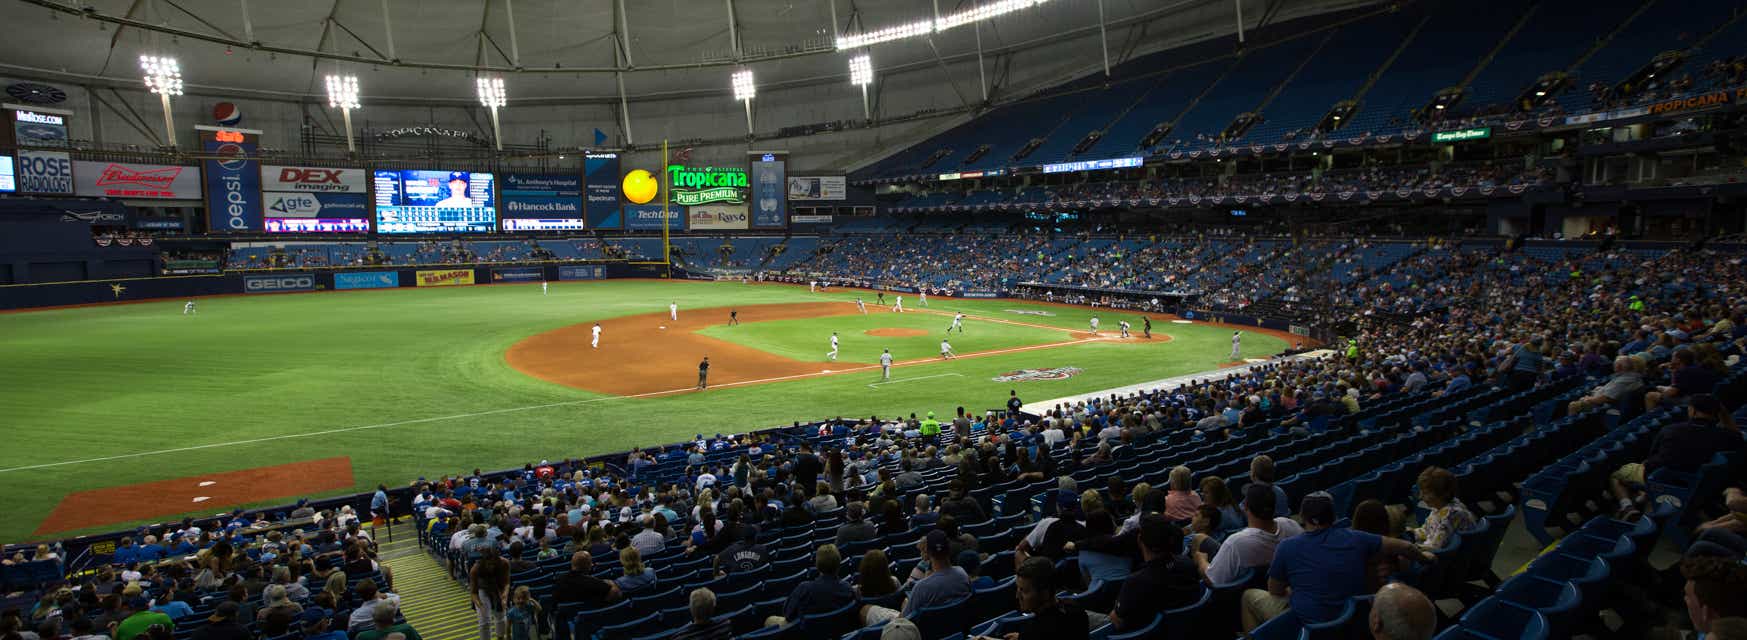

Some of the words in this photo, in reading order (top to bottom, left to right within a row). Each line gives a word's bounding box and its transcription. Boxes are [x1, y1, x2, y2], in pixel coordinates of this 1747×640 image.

[1648, 93, 1728, 113] TROPICANA
[20, 157, 70, 176] ROSE
[21, 175, 72, 193] RADIOLOGY
[279, 168, 344, 184] DEX
[526, 178, 553, 186] Anthony's
[668, 165, 748, 189] Tropicana
[294, 183, 350, 192] imaging
[222, 174, 248, 229] pepsi
[677, 192, 699, 203] PURE
[700, 189, 738, 201] PREMIUM
[518, 202, 555, 211] Hancock
[555, 202, 577, 211] Bank
[246, 277, 313, 290] GEICO
